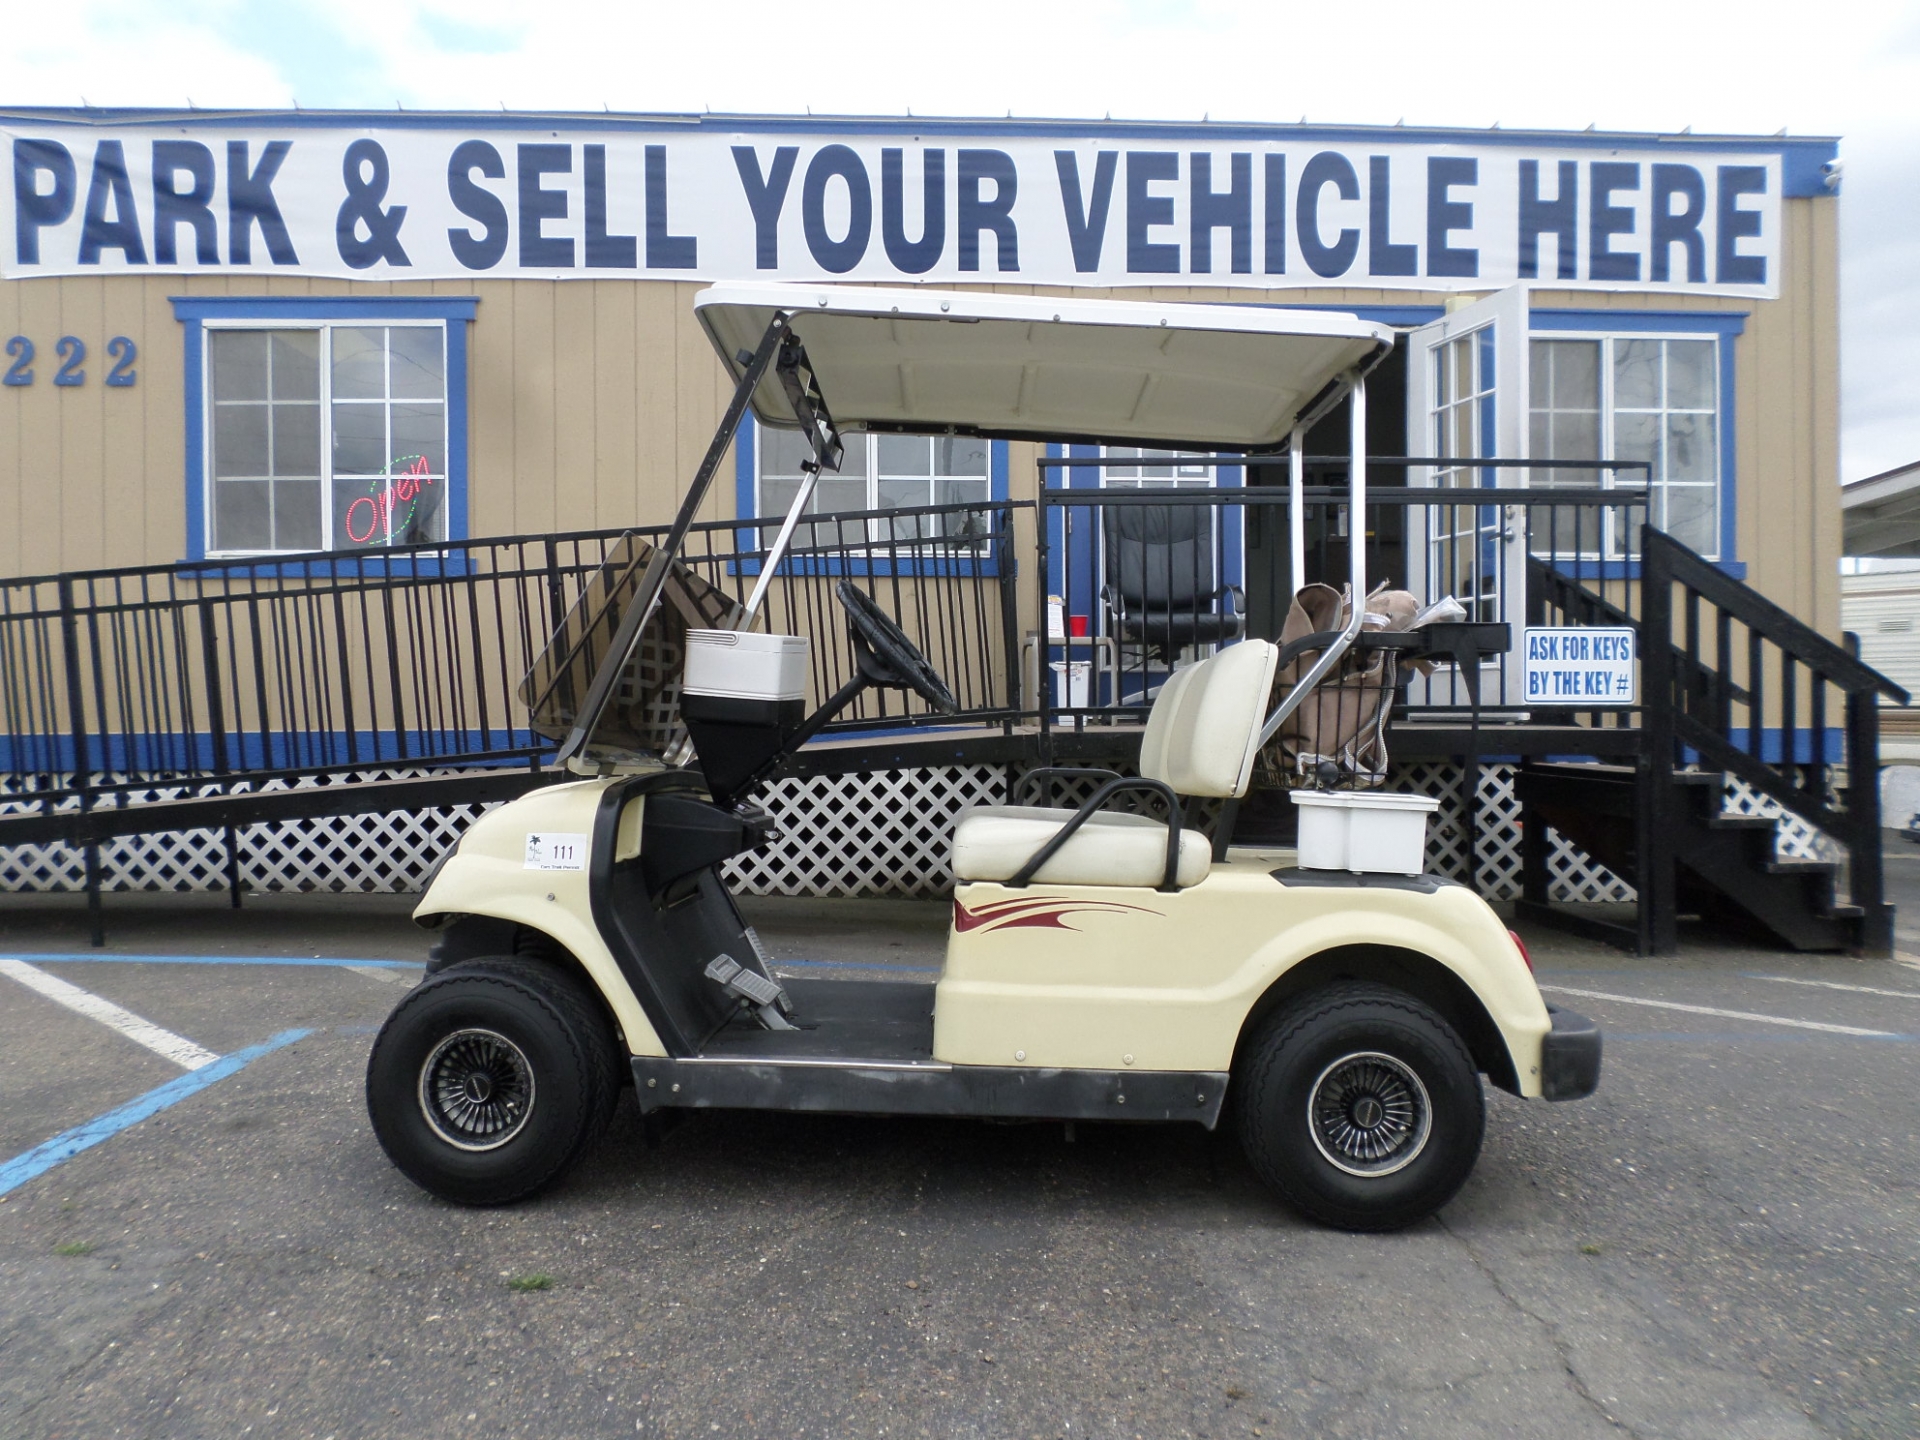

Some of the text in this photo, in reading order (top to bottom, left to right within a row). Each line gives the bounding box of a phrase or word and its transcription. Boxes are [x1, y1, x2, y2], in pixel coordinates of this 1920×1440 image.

[12, 138, 1767, 284] PARK & SELL YOUR VEHICLE HERE
[2, 335, 137, 387] 222
[1529, 636, 1629, 661] ASK FOR KEYS
[1529, 671, 1629, 695] BY THE KEY #
[554, 845, 573, 860] 111
